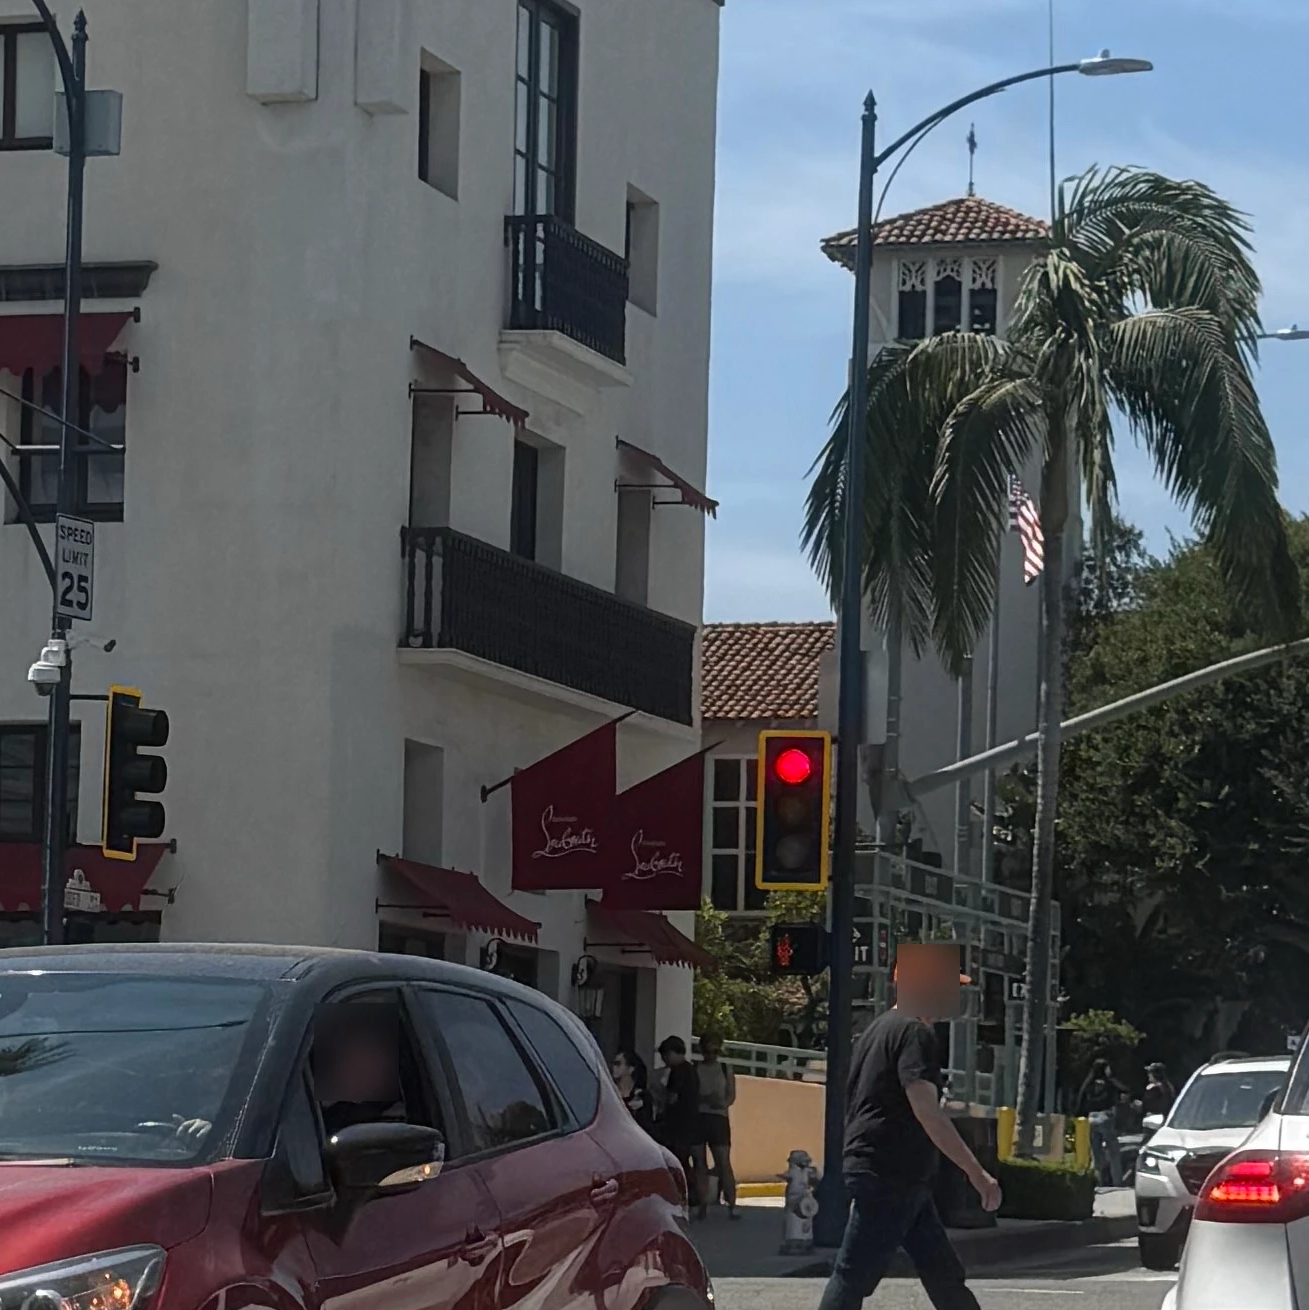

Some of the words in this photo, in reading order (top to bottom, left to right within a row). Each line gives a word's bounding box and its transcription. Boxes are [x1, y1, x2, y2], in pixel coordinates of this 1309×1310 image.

[59, 525, 93, 546] SPEED
[62, 547, 89, 568] LIMIT
[60, 571, 89, 611] 25
